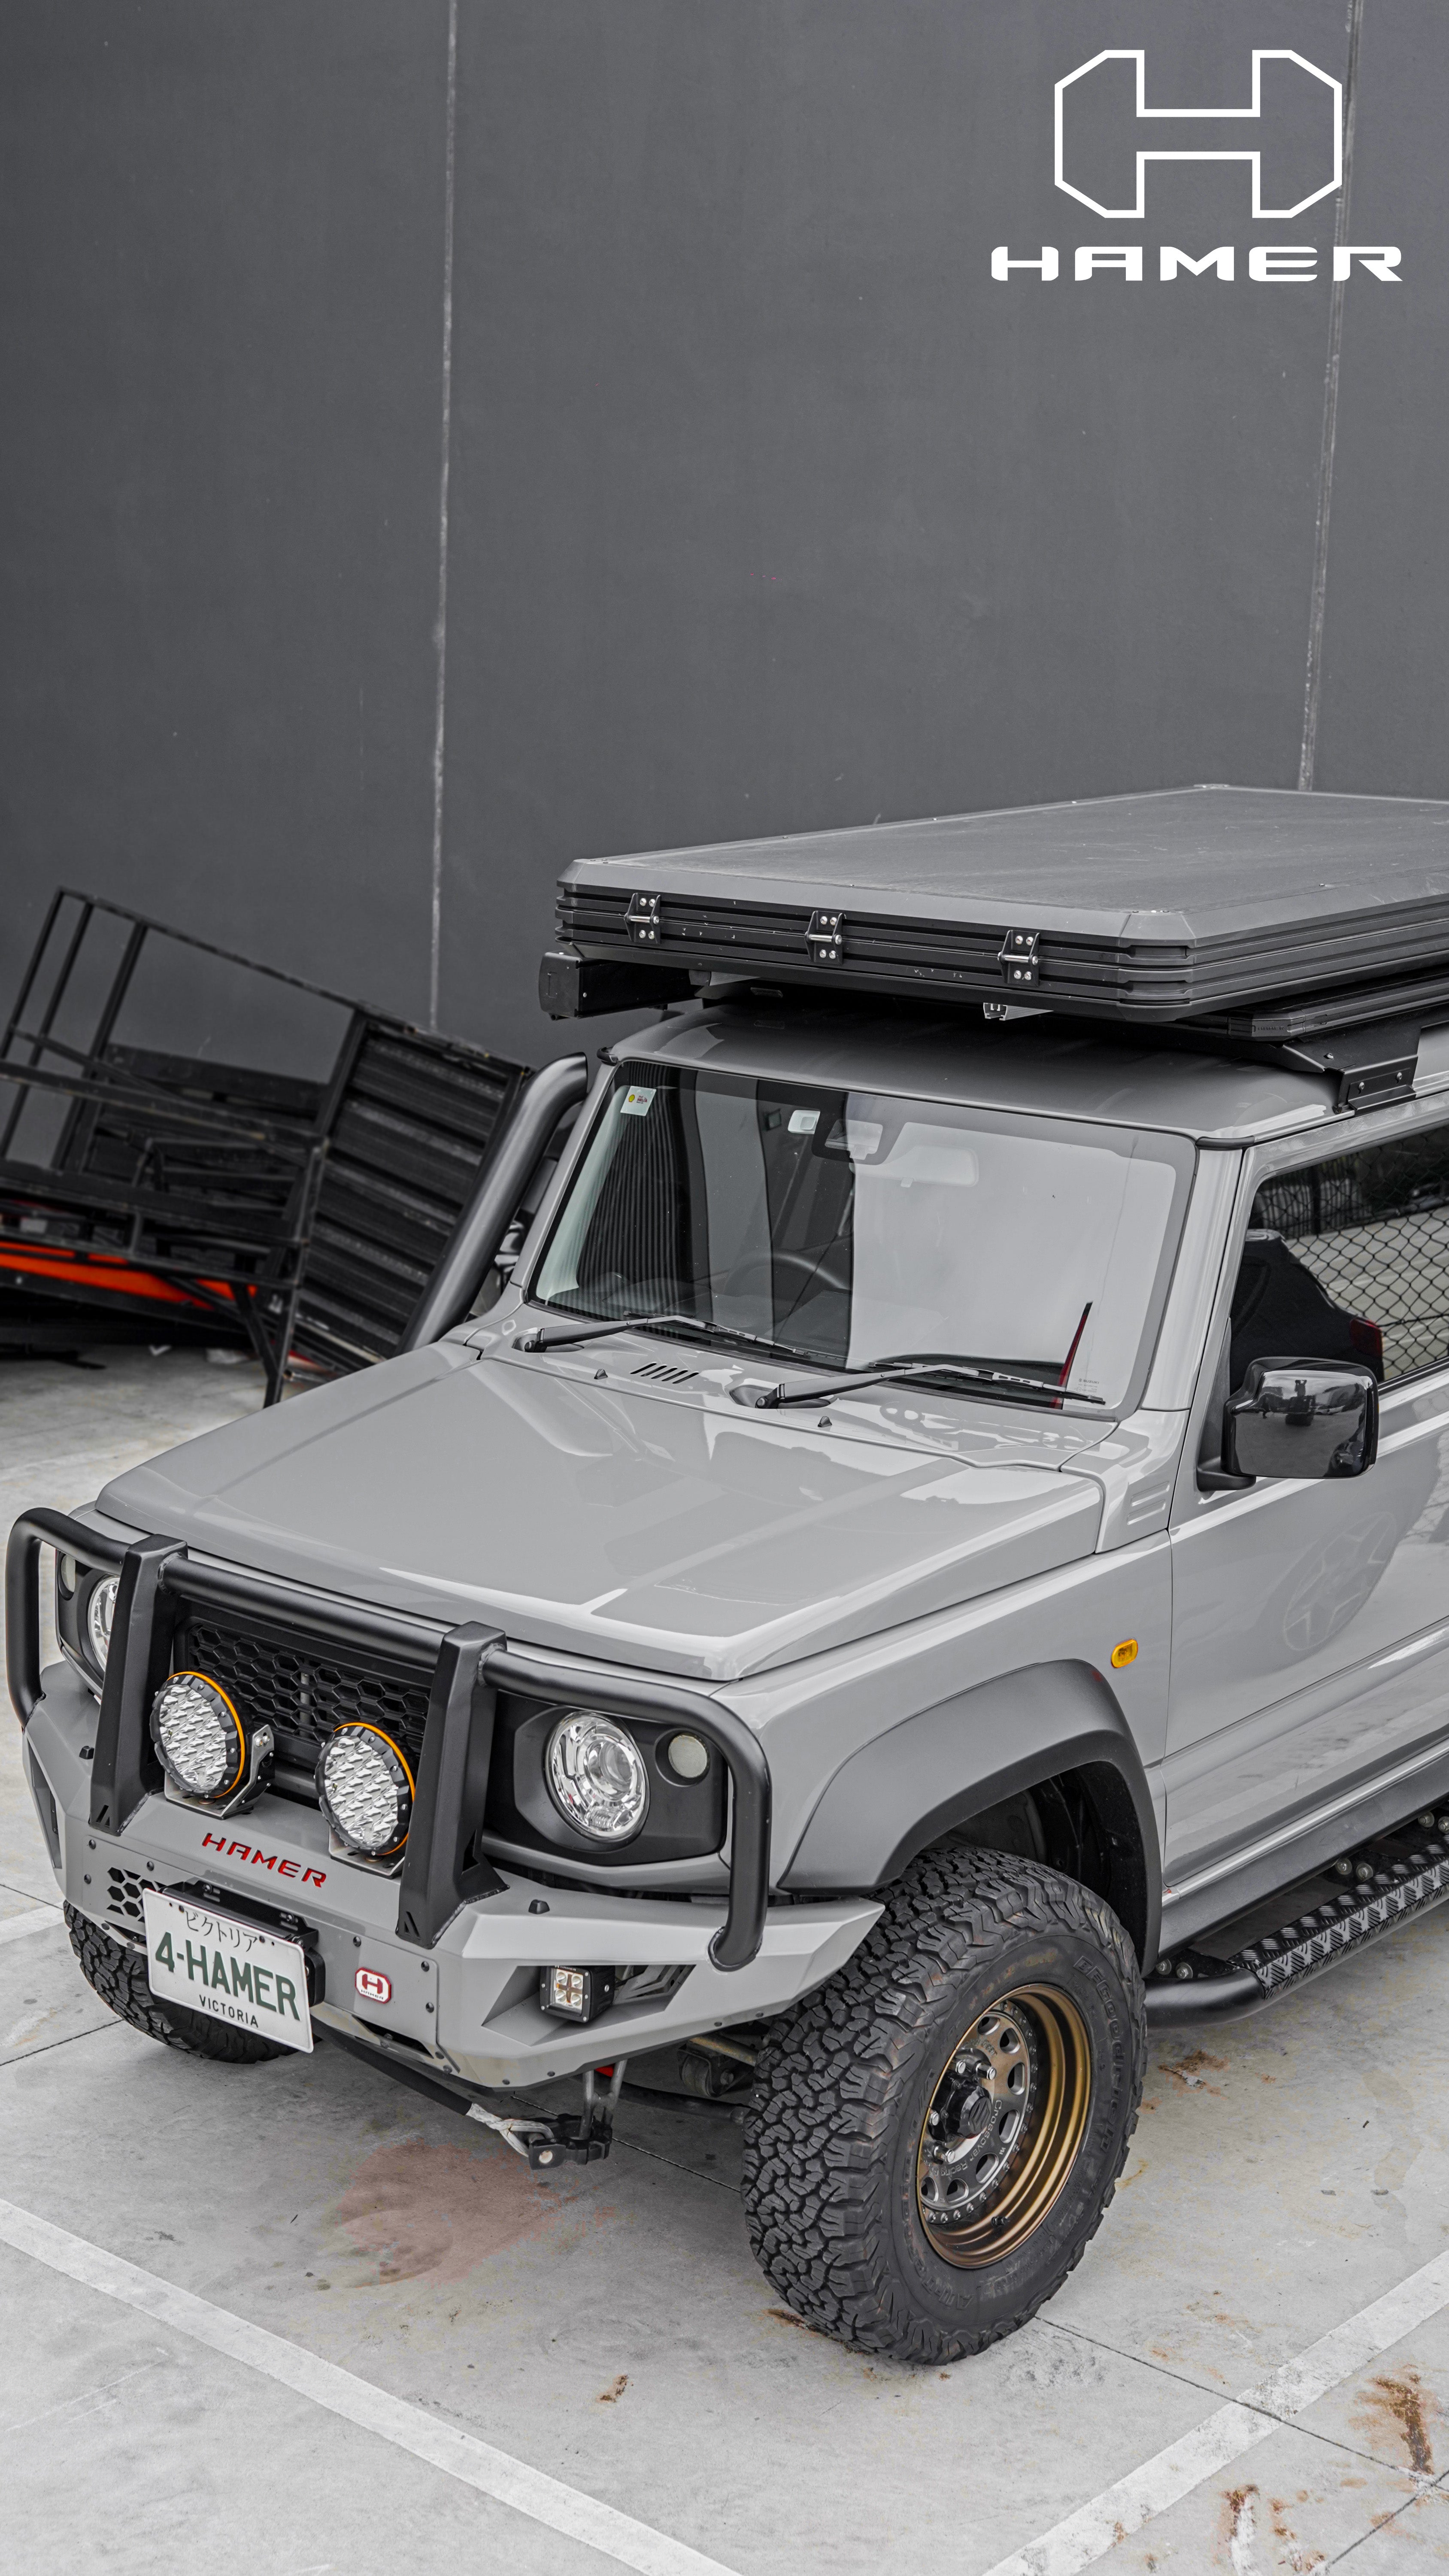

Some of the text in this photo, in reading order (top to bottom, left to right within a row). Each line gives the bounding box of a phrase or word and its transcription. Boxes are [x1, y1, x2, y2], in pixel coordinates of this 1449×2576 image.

[201, 1832, 327, 1888] HAMER
[185, 1911, 258, 1952] ビクトリア
[155, 1931, 300, 2021] 4-HAMER
[199, 1994, 258, 2028] VICTORIA
[1074, 1956, 1126, 2153] BFGoodrich
